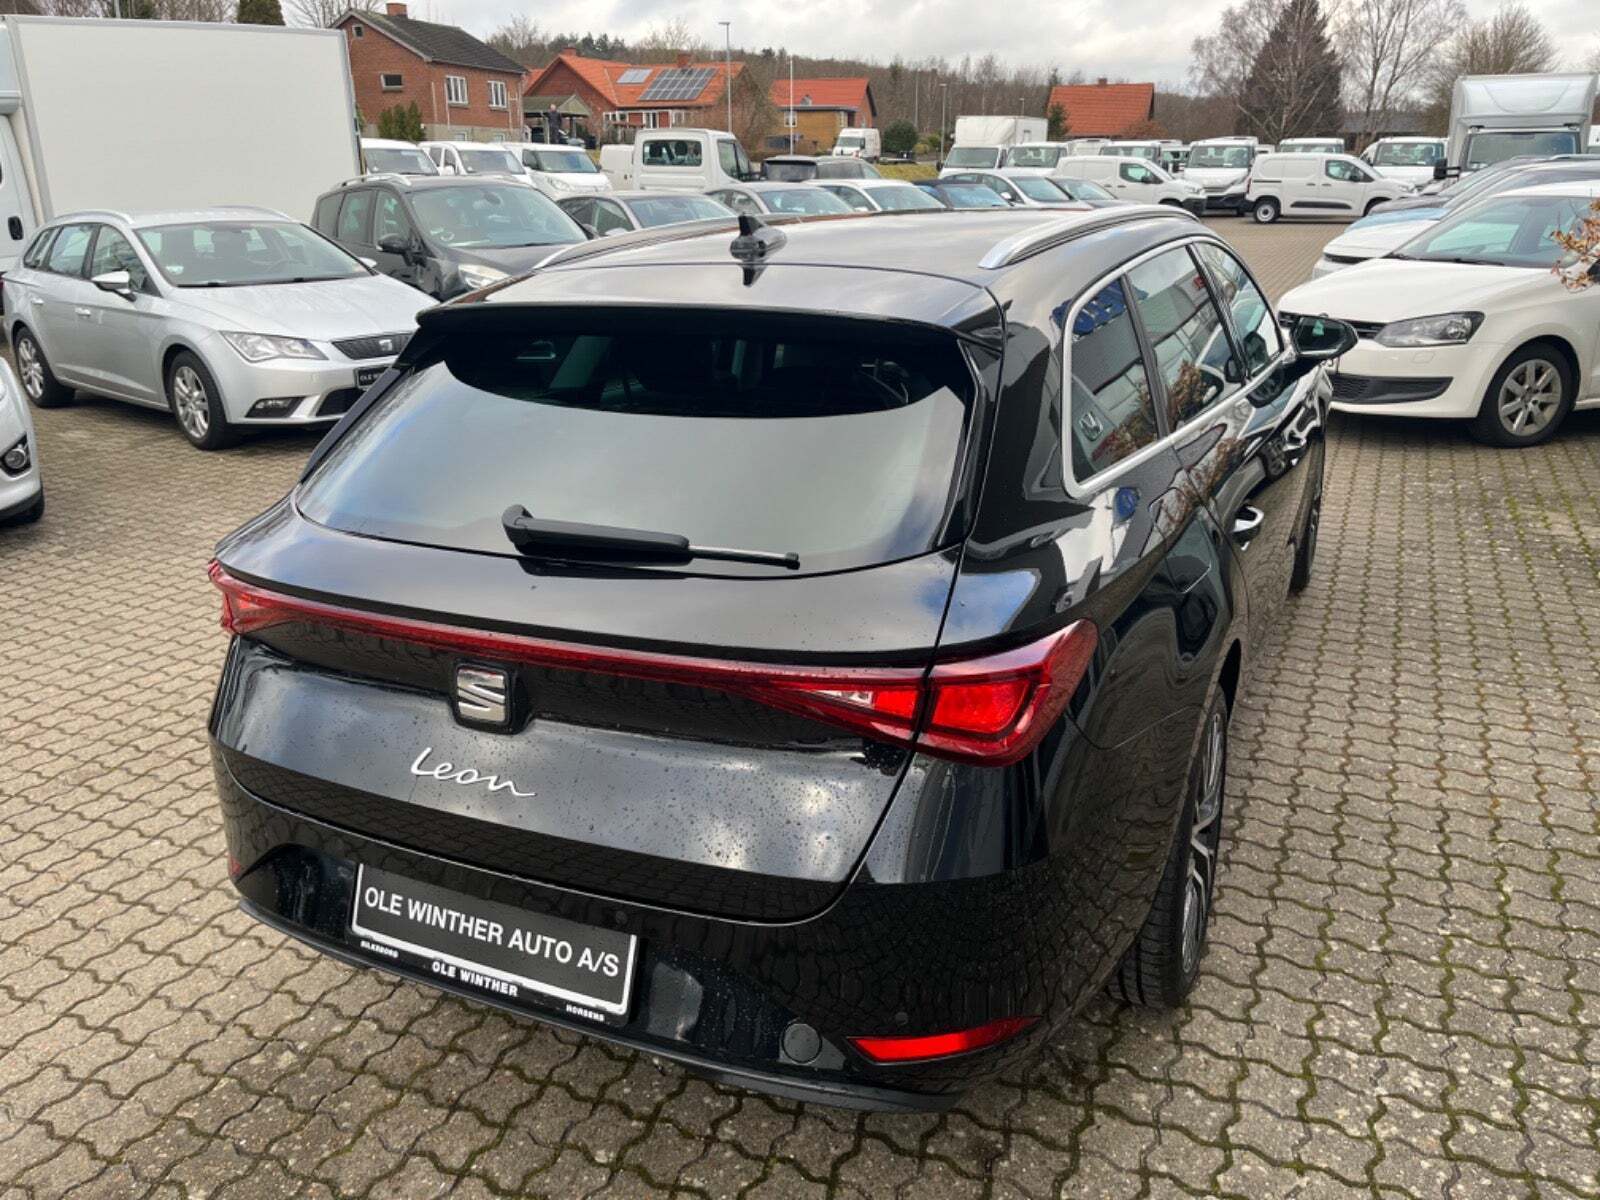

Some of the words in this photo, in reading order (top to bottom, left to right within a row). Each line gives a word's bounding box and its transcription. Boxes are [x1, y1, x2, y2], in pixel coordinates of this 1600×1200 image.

[410, 747, 536, 797] Leon
[364, 887, 402, 916] OLE
[407, 898, 503, 945] WINTHER
[508, 928, 573, 963] AUTO
[577, 947, 619, 977] A/S
[432, 961, 456, 978] OLE
[460, 970, 518, 997] WINTHER
